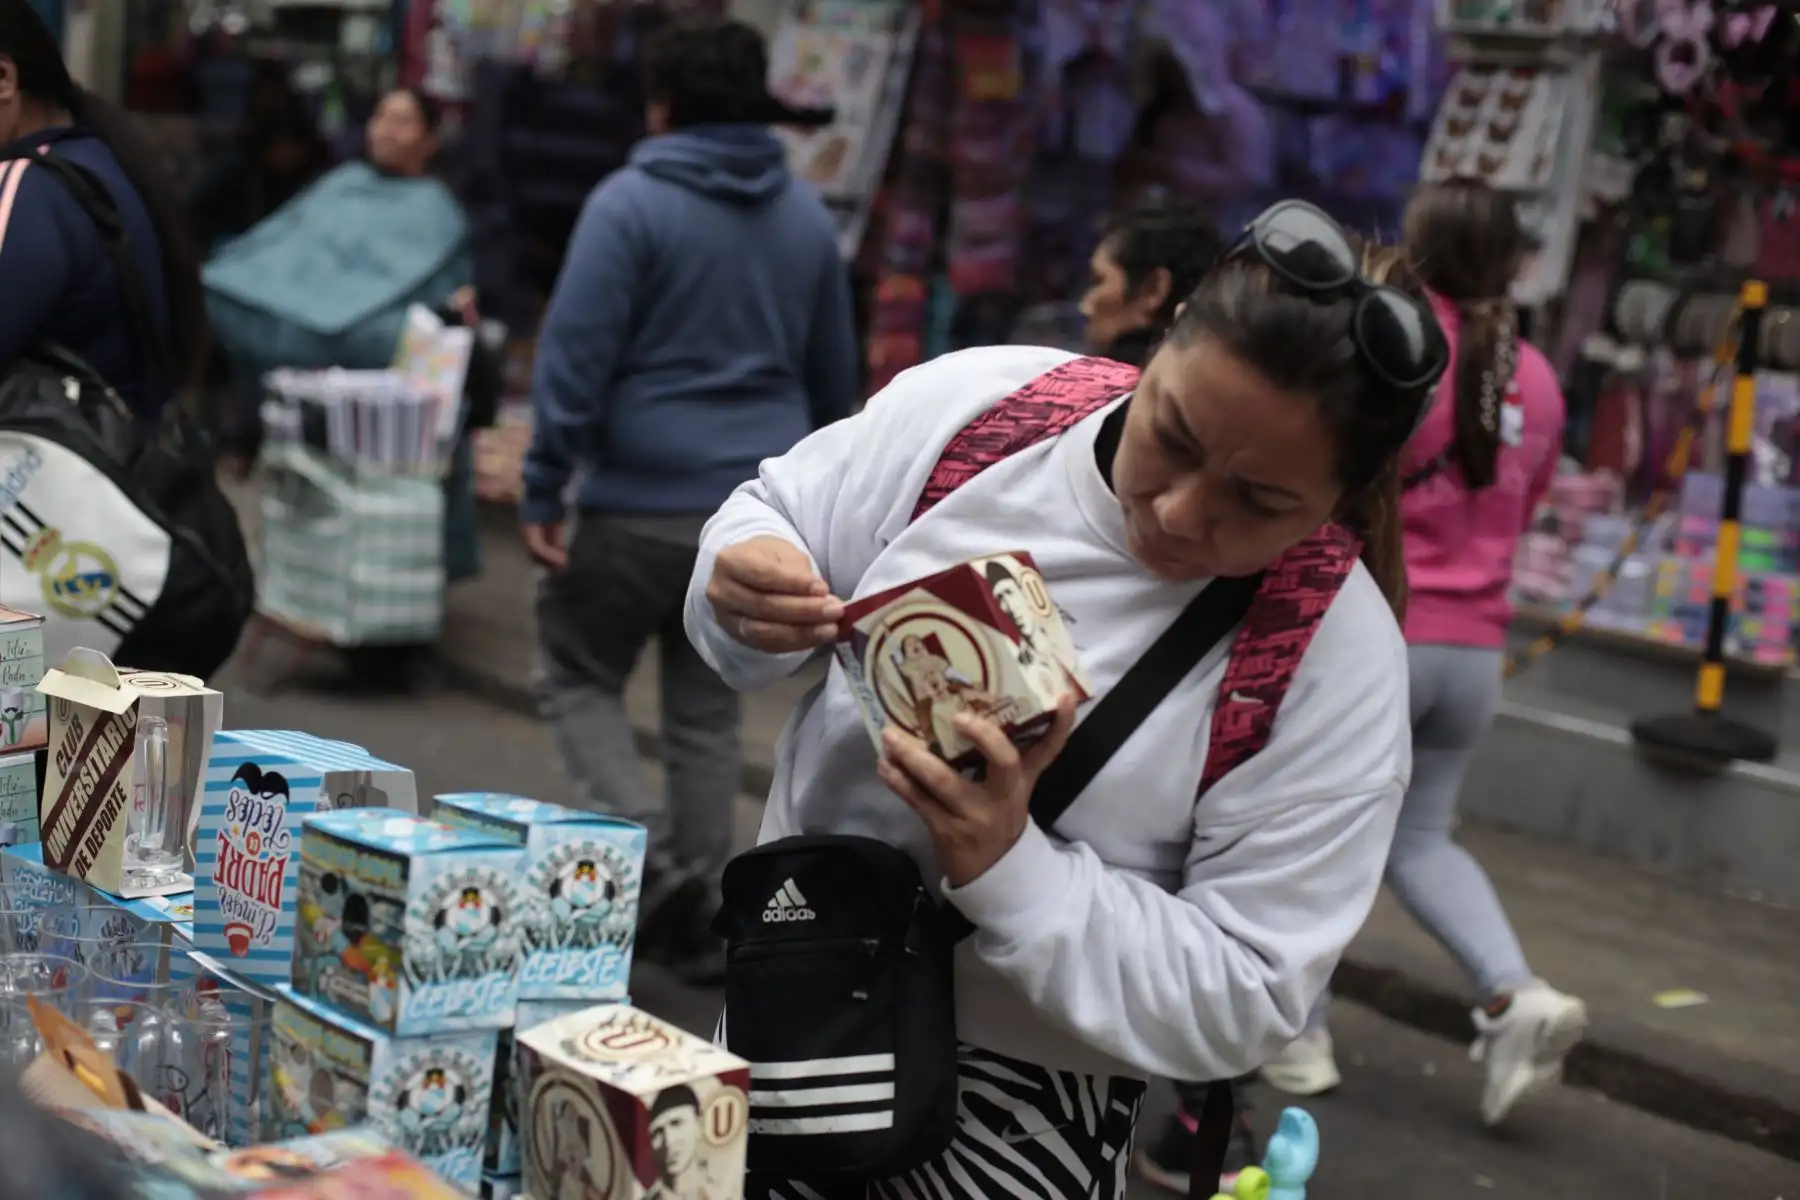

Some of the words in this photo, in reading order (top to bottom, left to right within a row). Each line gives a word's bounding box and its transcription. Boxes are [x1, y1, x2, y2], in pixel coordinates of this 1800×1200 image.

[56, 713, 84, 778] CLUB
[47, 708, 137, 864] UNIVERSITARIO
[74, 848, 92, 880] DE
[84, 781, 127, 860] DEPORTE
[226, 790, 290, 850] Todos
[214, 831, 287, 909] PADRE
[762, 906, 816, 922] adidas
[713, 1101, 734, 1139] U
